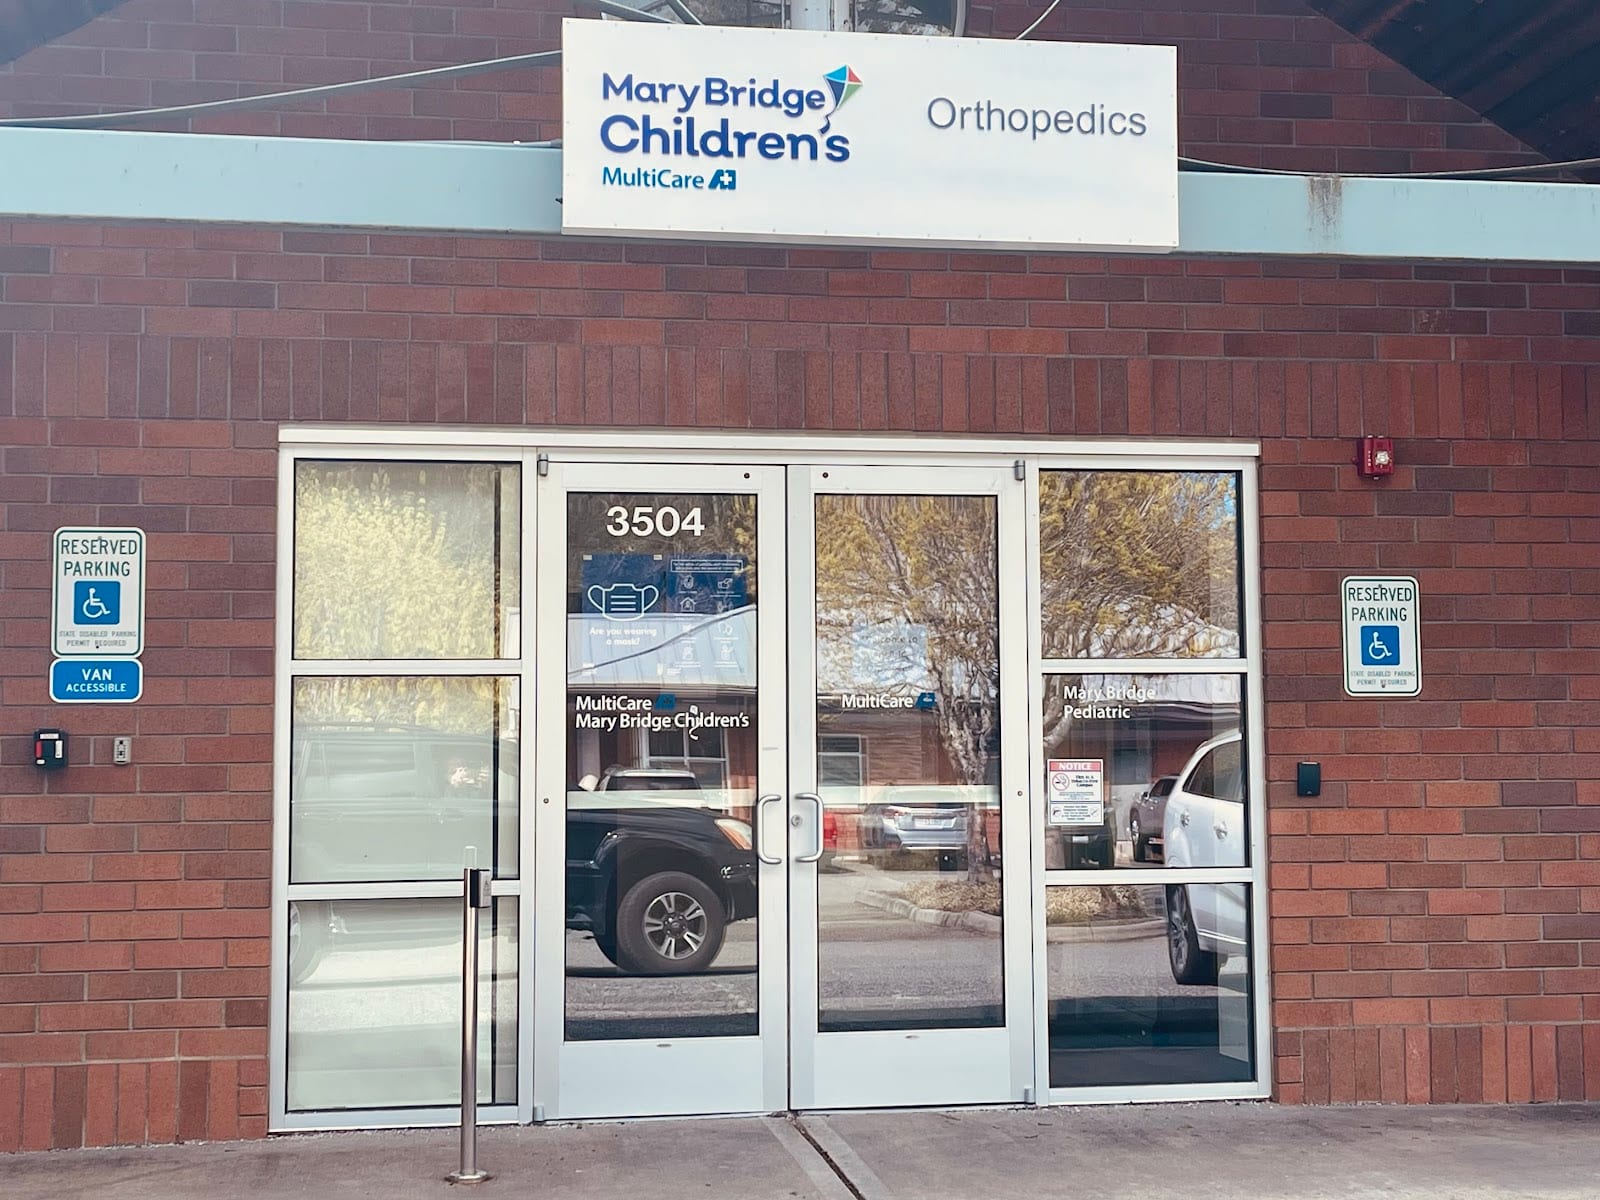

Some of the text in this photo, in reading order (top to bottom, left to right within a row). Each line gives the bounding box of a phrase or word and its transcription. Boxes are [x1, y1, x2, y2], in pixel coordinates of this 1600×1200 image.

[602, 72, 826, 118] Mary Bridge
[927, 97, 1148, 141] Orthopedics
[600, 114, 851, 162] Children's
[602, 166, 704, 189] MultiCare
[606, 505, 705, 537] 3504
[61, 539, 138, 555] RESERVED
[64, 560, 131, 577] PARKING
[1348, 587, 1412, 602] RESERVED
[1351, 607, 1408, 622] PARKING
[79, 630, 108, 638] DISABLED
[589, 627, 657, 637] Are you wearing
[66, 639, 127, 647] PERMIT REQUIRED
[82, 668, 112, 681] VAN
[66, 683, 127, 693] ACCESSIBLE
[1063, 685, 1156, 703] Mary Bridge
[575, 695, 652, 711] MultiCare
[842, 694, 914, 708] MultiCare
[1063, 705, 1131, 719] Pediatric
[575, 712, 750, 733] Mary Bridge Children's
[1058, 762, 1092, 771] NOTICE
